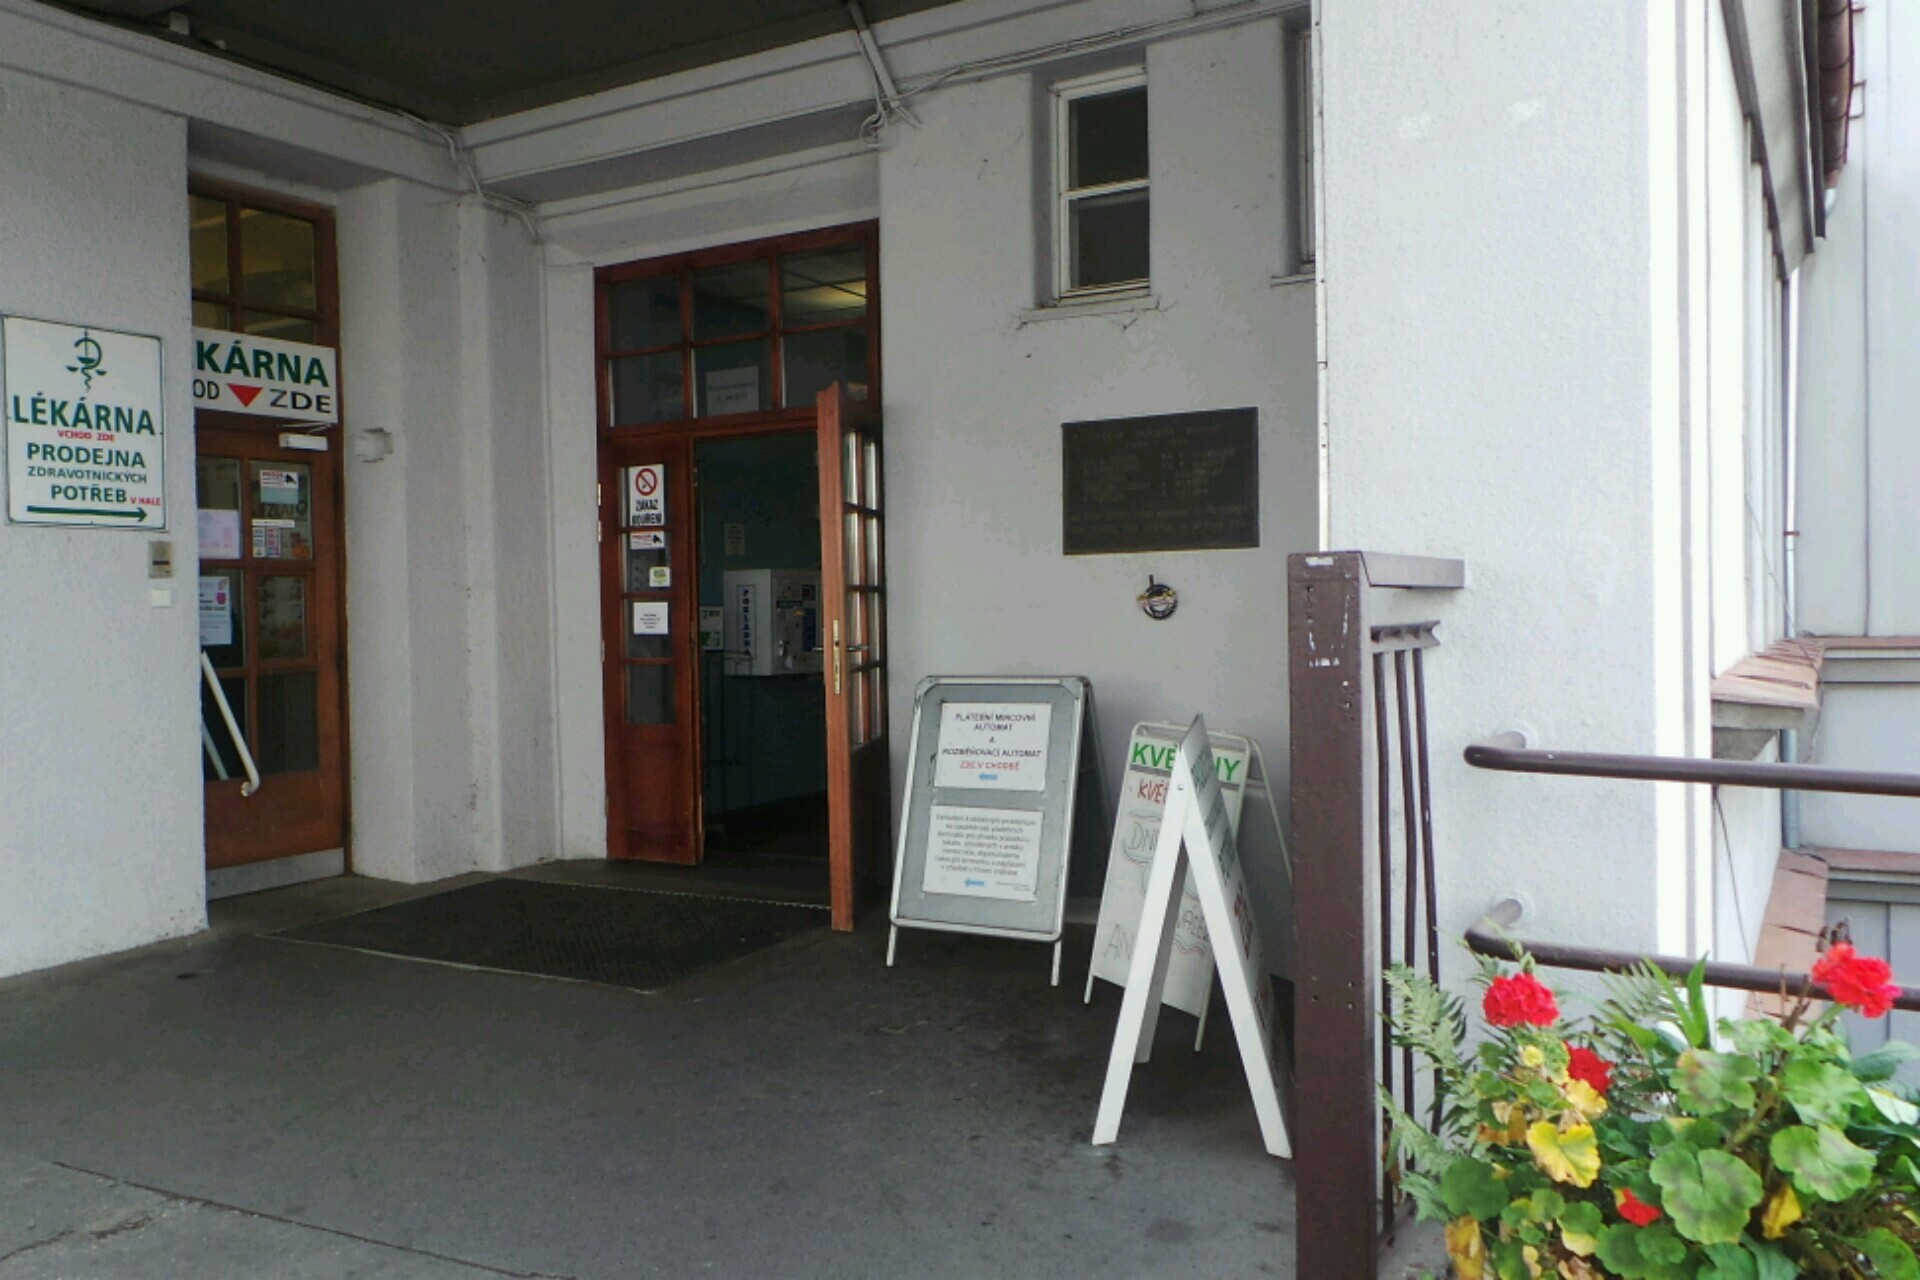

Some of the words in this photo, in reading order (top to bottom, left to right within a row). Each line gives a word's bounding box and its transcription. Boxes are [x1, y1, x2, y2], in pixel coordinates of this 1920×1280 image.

[196, 339, 330, 388] KÁRNA
[193, 379, 220, 400] OD
[269, 388, 331, 414] ZDE
[12, 391, 156, 436] LÉKÁRNA
[57, 430, 92, 440] VCHOD
[96, 433, 115, 442] ZDE
[27, 442, 146, 468] PRODEJNA
[27, 466, 148, 484] ZDRAVOTNICKÝCH
[51, 484, 127, 503] POTŘEB
[130, 496, 137, 505] V
[137, 497, 161, 506] HALE
[974, 723, 1013, 732] AUTOMAT
[977, 761, 984, 769] V
